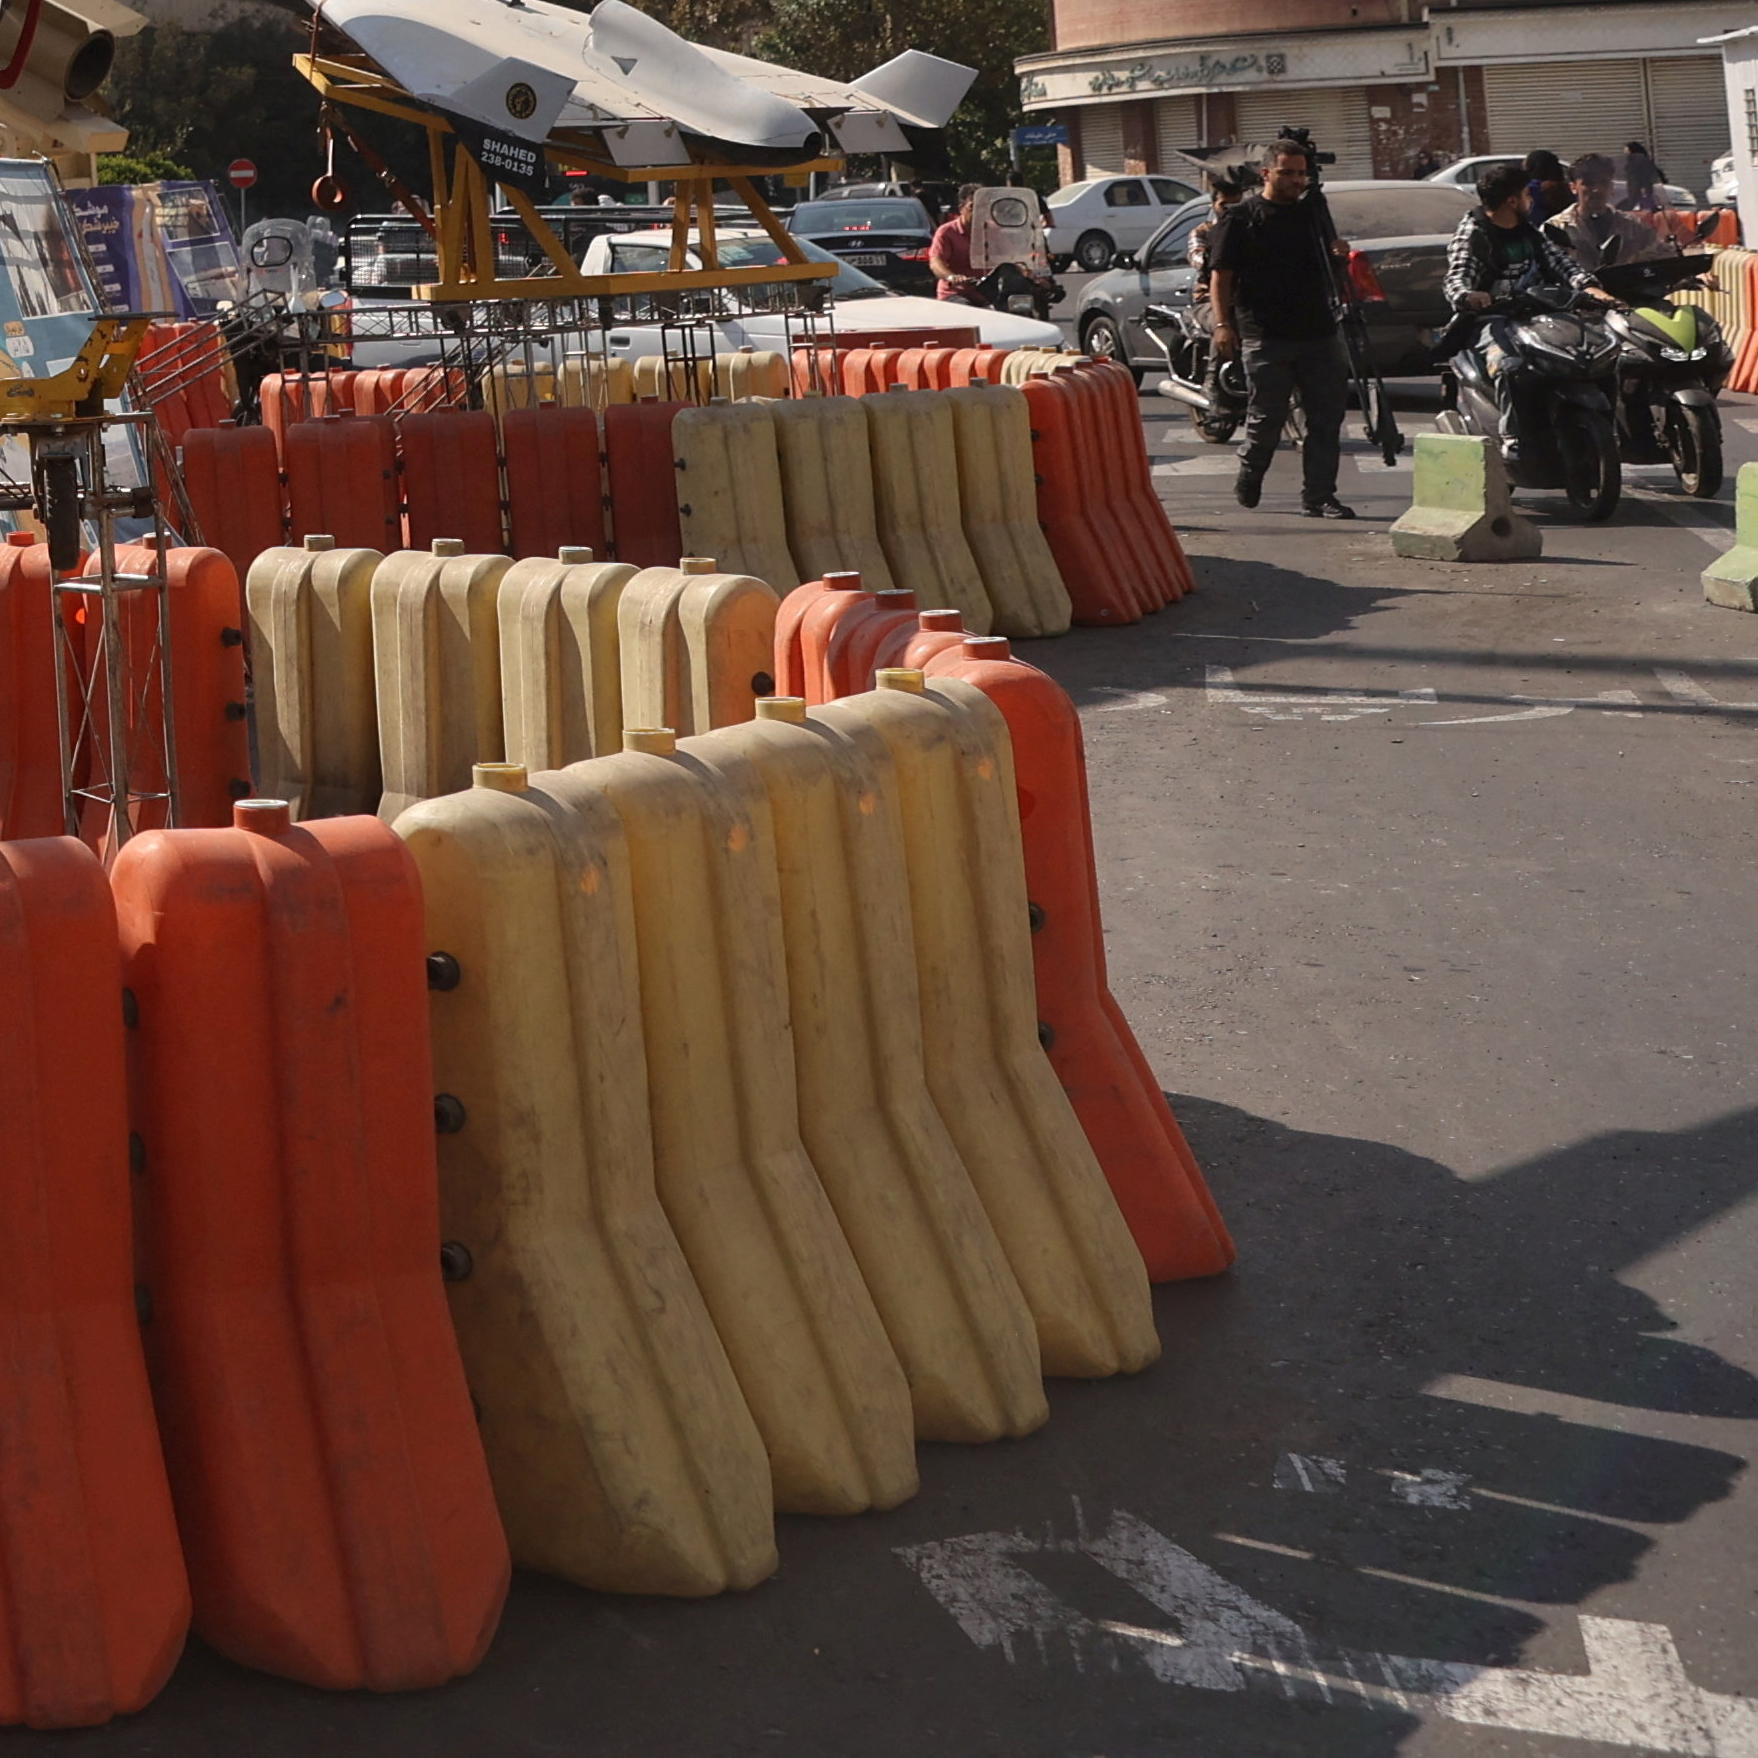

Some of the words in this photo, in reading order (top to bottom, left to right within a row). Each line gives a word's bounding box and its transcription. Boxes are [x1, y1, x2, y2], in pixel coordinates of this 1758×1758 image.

[482, 138, 537, 163] SHAHED
[481, 151, 534, 177] 238-0135
[83, 216, 120, 234] خیبرشک
